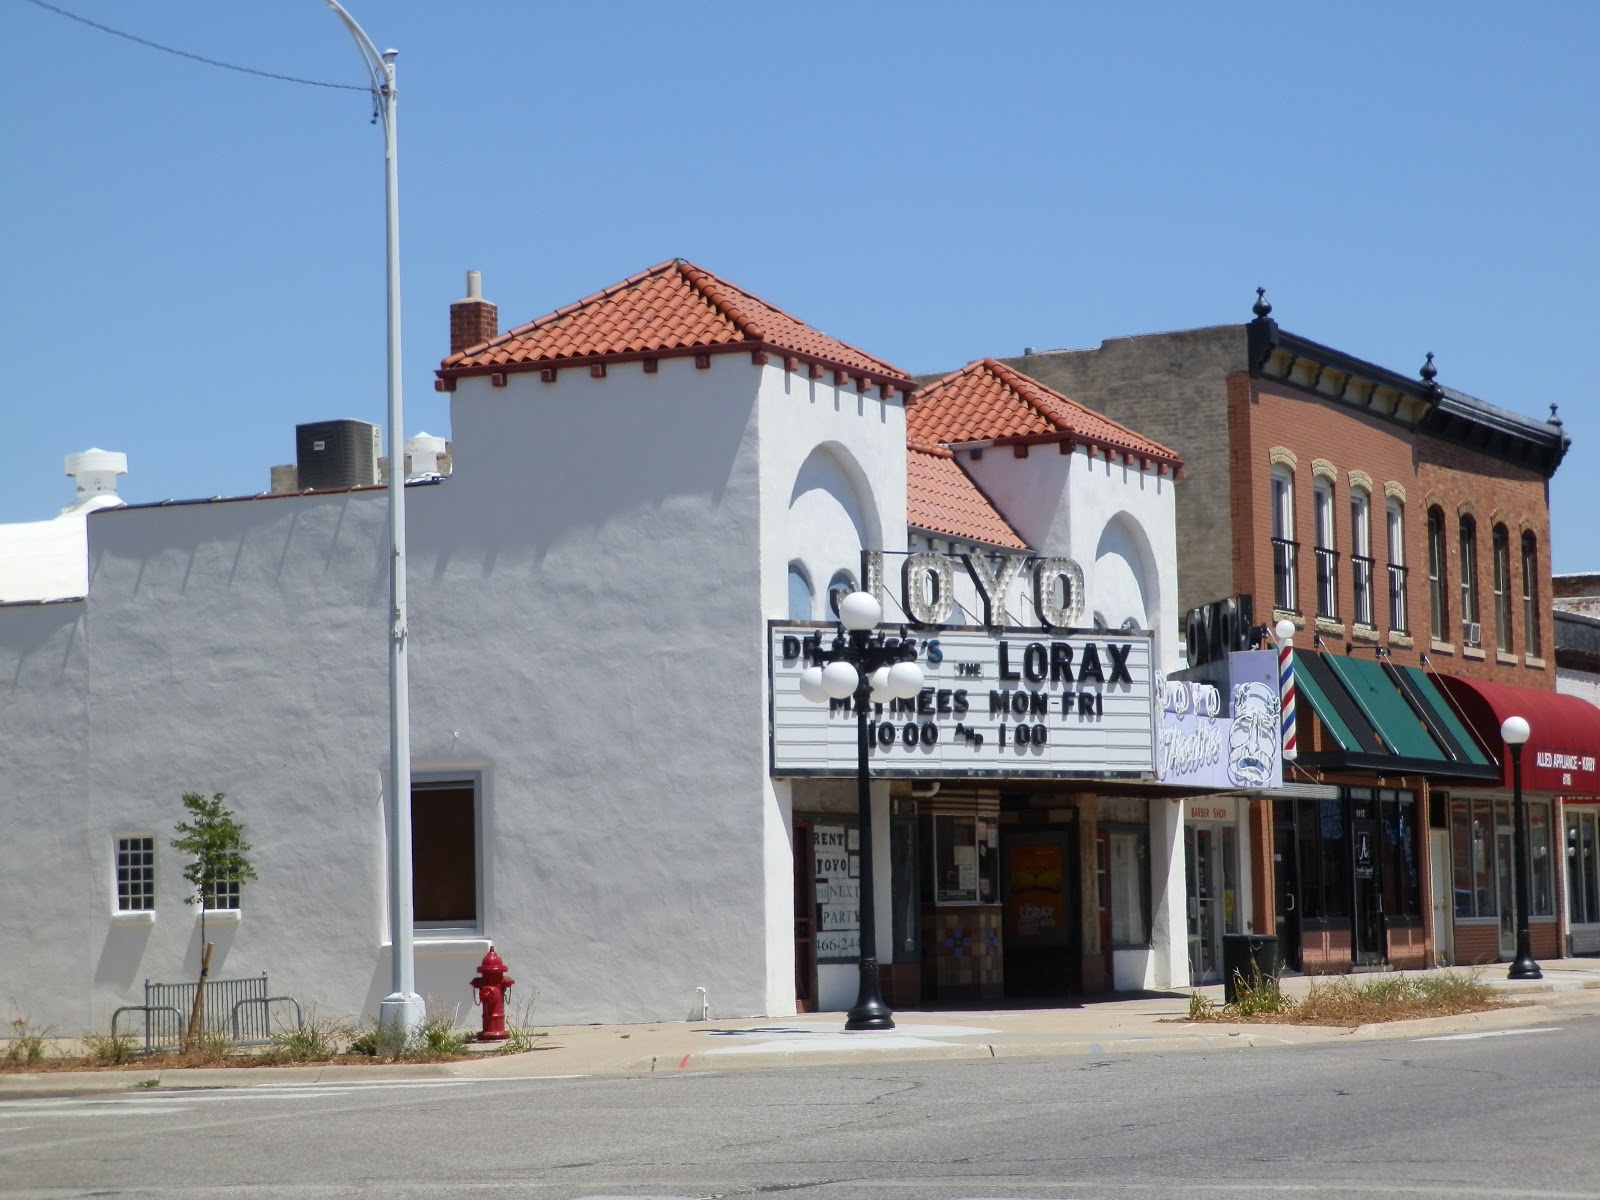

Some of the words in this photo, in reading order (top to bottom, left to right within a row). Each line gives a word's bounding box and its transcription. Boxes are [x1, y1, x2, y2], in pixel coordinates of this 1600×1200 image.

[830, 550, 1085, 628] JOYO
[832, 638, 943, 665] SS'S
[958, 662, 982, 675] THE
[1000, 641, 1133, 683] LORAX
[829, 686, 969, 715] MINEES
[989, 689, 1103, 716] MON-FRI
[869, 720, 938, 746] 10:00
[955, 723, 984, 746] AND
[1000, 723, 1047, 747] 1:00
[1537, 752, 1552, 767] ALLIED
[1553, 754, 1577, 769] APPLIANCE
[1191, 807, 1209, 818] BARBER
[1213, 808, 1226, 819] SHOP
[814, 832, 843, 846] RENT
[816, 859, 847, 874] JOYO
[829, 885, 860, 898] NEXT
